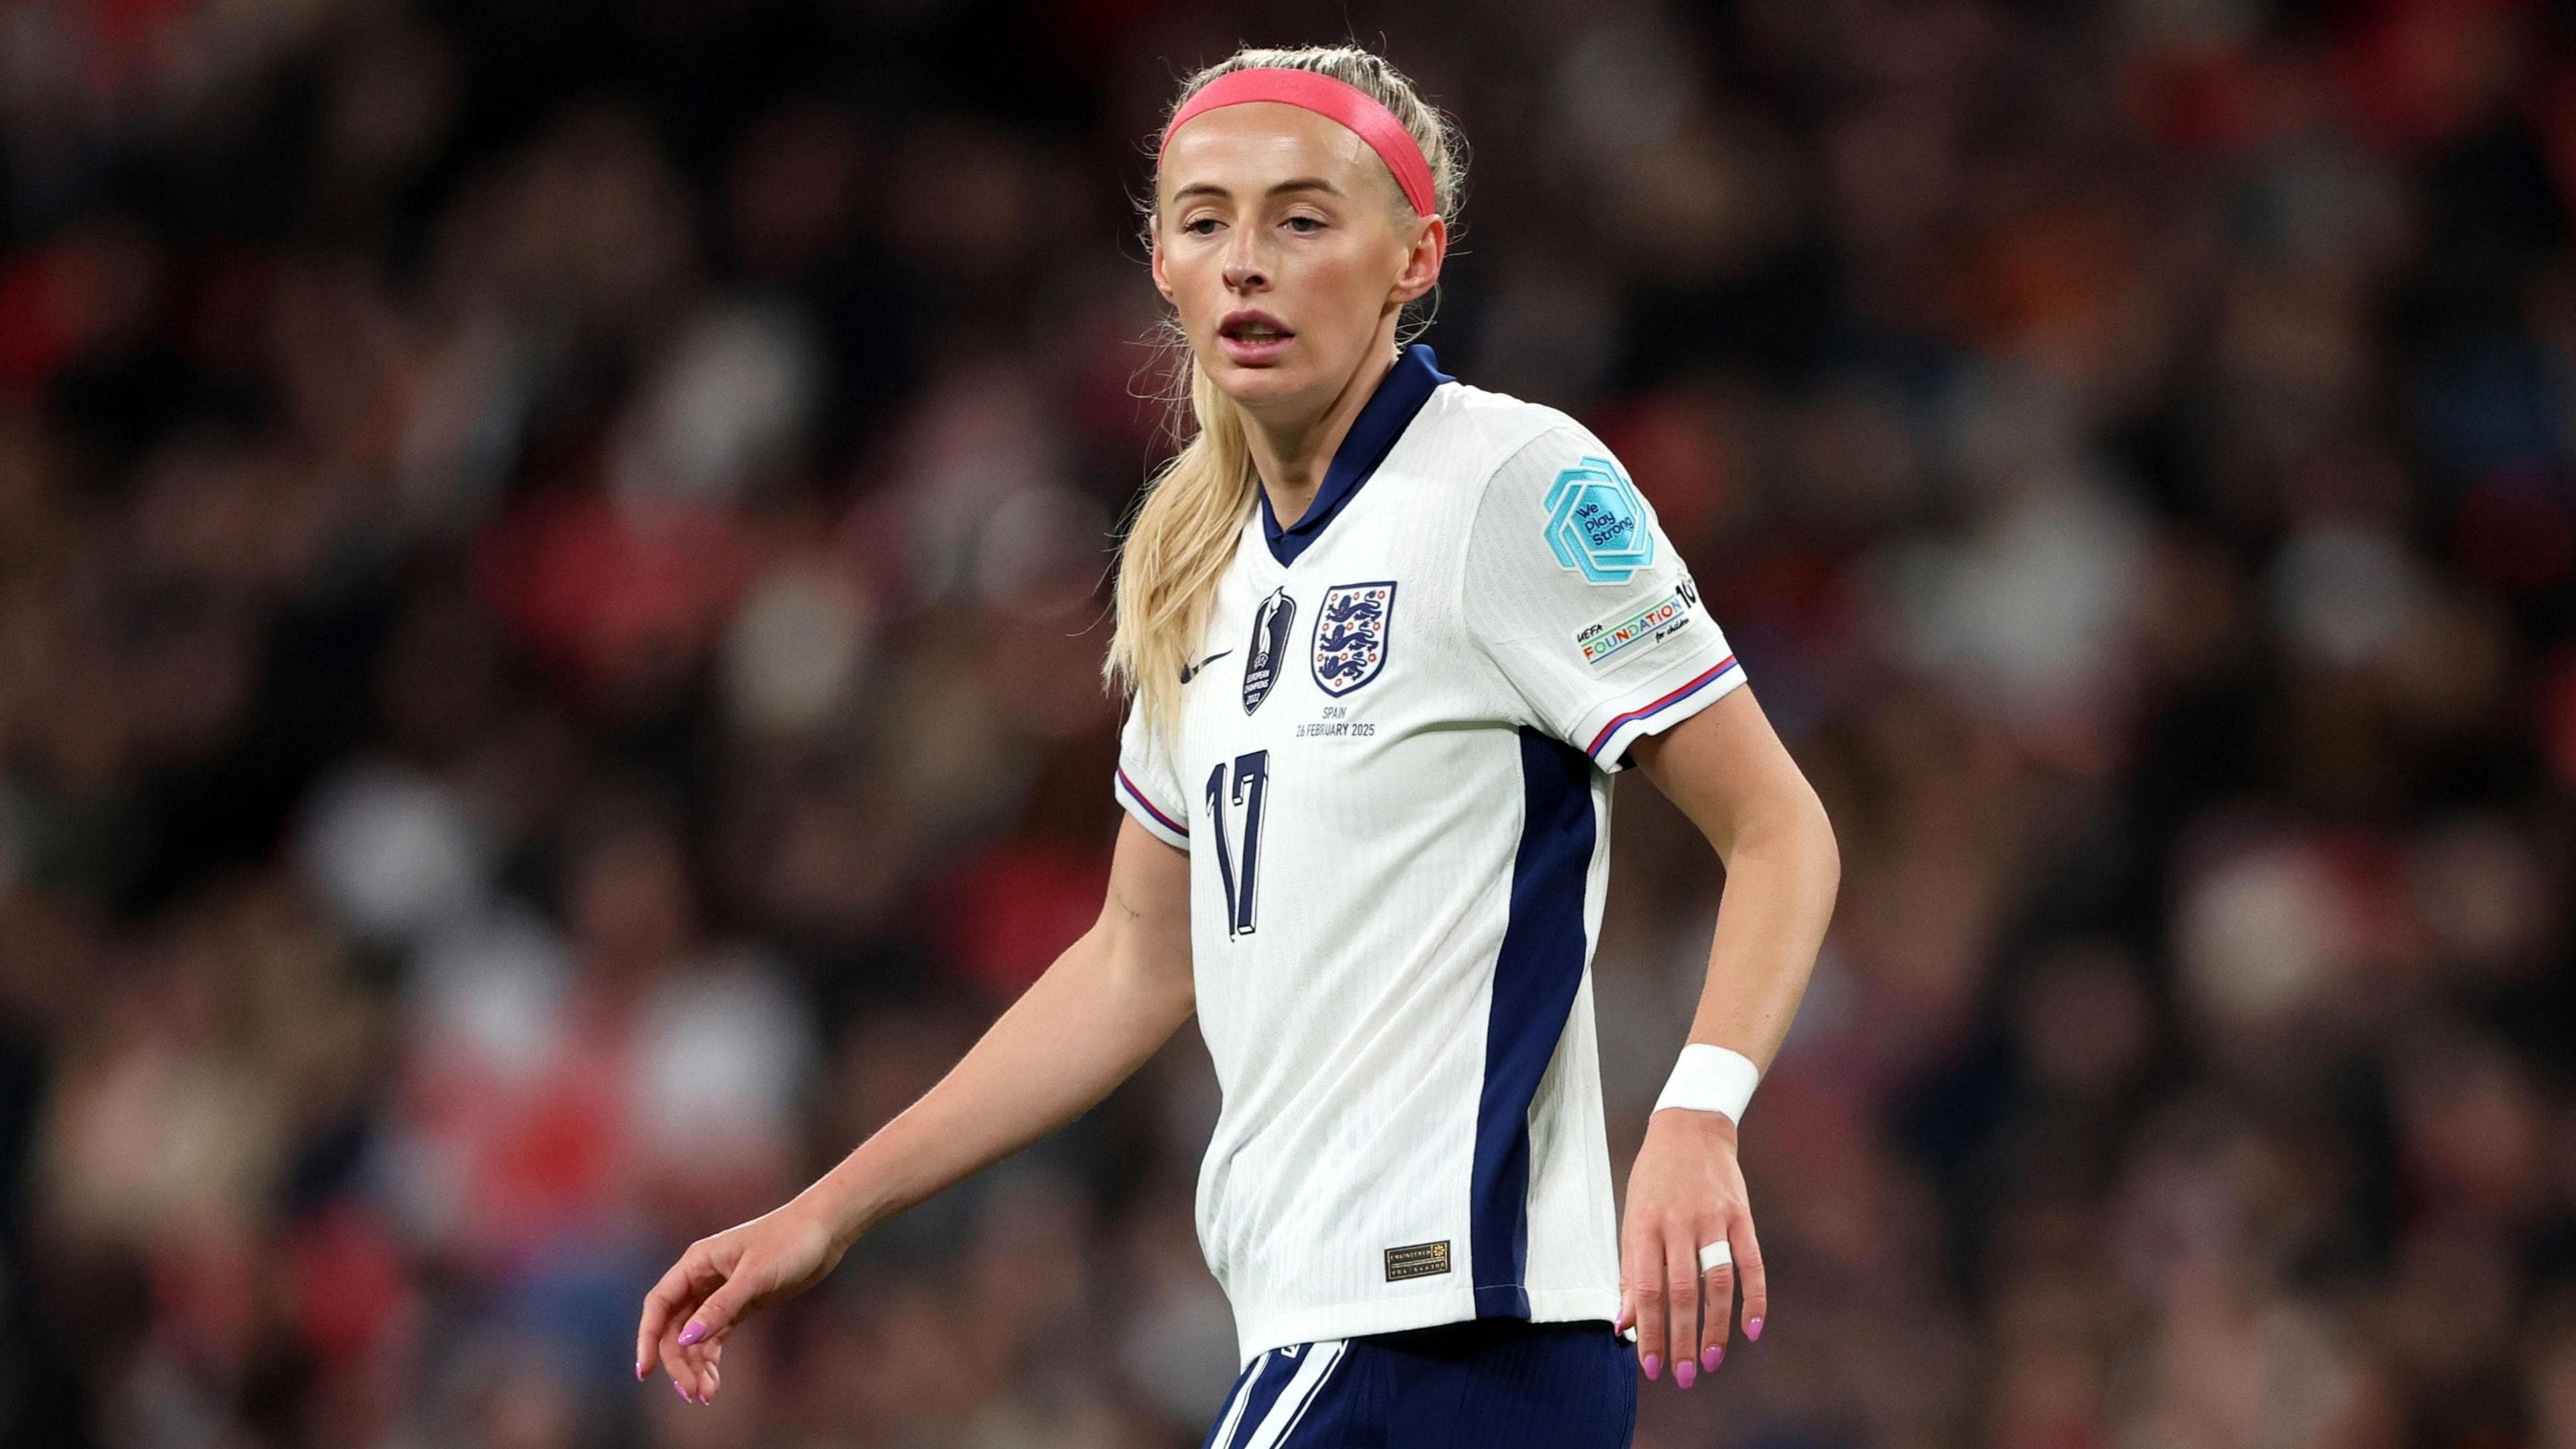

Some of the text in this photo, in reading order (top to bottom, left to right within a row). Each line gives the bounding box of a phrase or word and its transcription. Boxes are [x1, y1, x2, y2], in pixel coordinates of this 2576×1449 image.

[1576, 503, 1599, 519] We
[1585, 511, 1616, 534] Play
[1593, 516, 1634, 546] Strong
[1577, 624, 1603, 643] UEFA
[1246, 692, 1261, 705] 2022
[1322, 706, 1347, 720] SPAIN
[1296, 723, 1375, 738] 26 FEBRUARY 2025
[1205, 749, 1270, 944] 17
